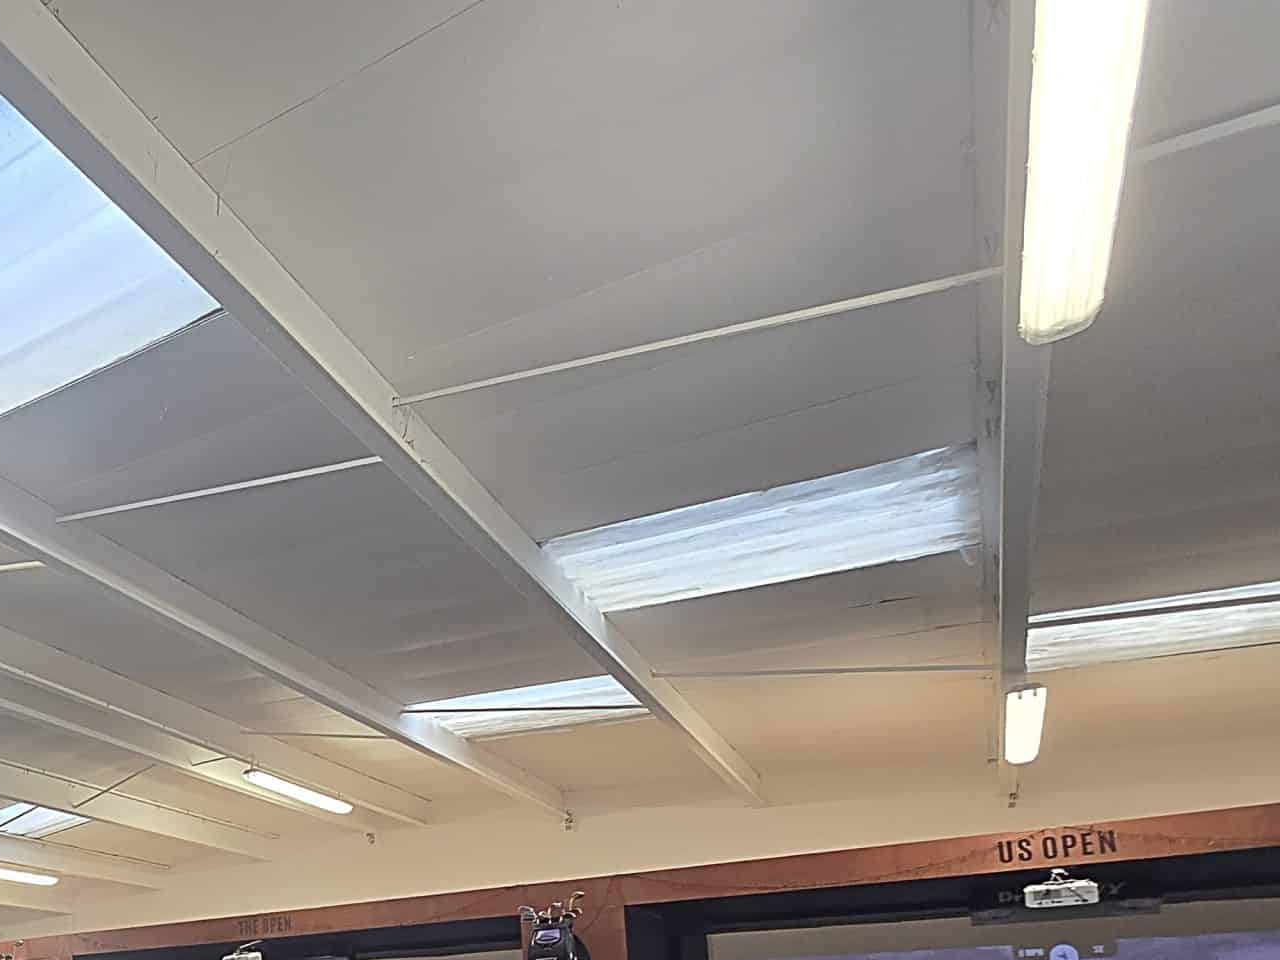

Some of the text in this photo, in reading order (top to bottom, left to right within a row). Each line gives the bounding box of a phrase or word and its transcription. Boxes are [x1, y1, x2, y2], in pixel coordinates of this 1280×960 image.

[998, 830, 1117, 863] US OPEN
[237, 915, 292, 937] THE OPEN
